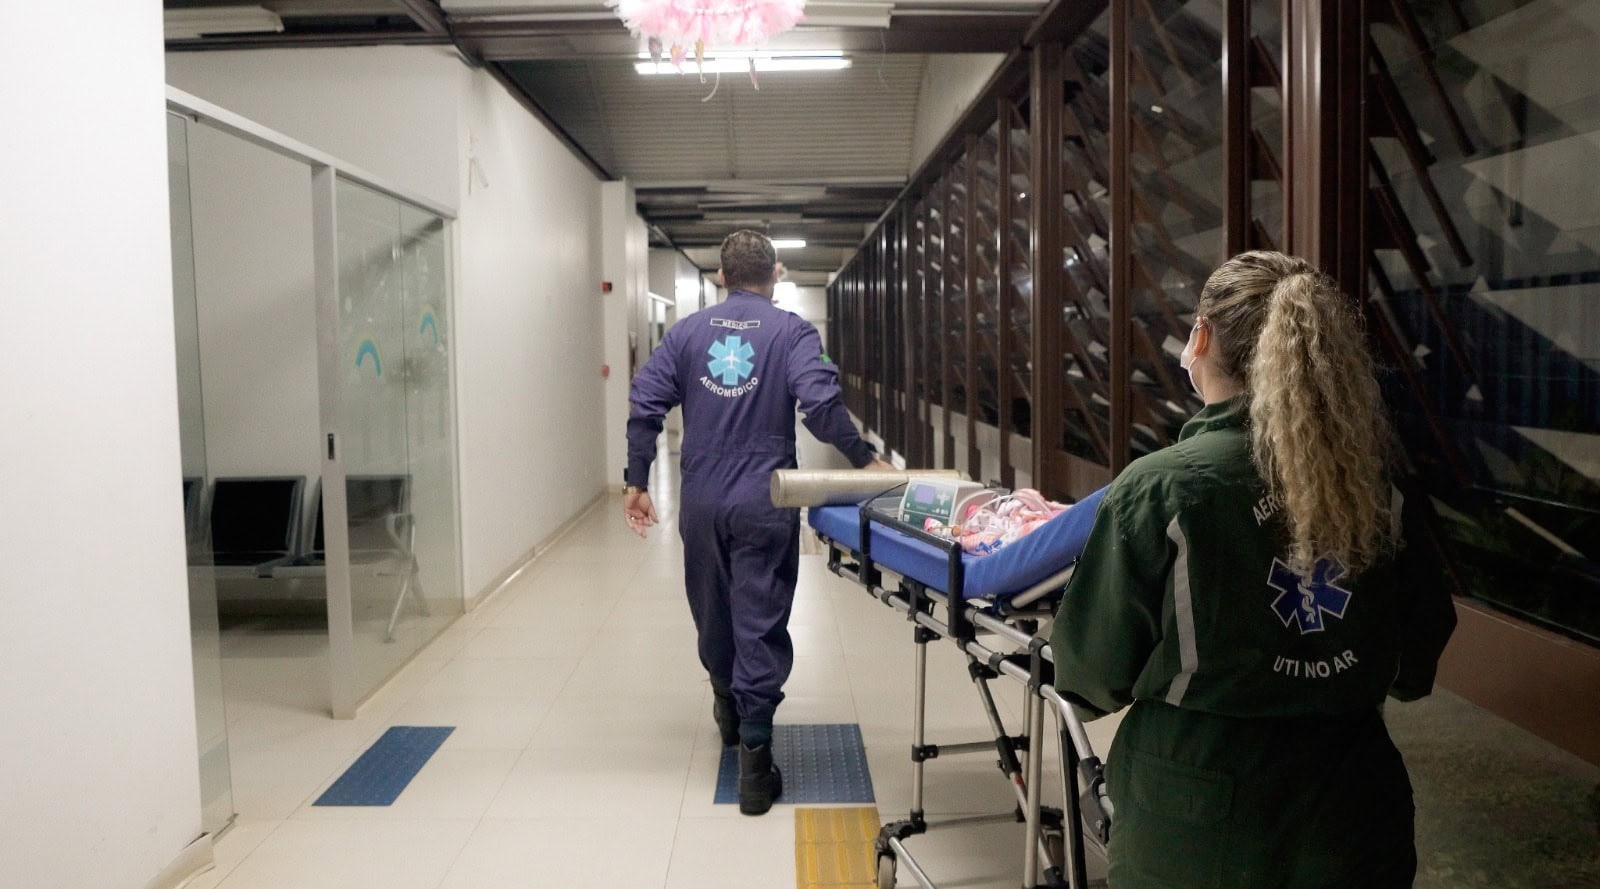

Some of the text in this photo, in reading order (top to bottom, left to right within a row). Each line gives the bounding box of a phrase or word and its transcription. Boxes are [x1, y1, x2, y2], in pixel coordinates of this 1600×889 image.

[699, 376, 759, 397] AEROMÉDICO
[1273, 649, 1359, 678] UTI NO AR
